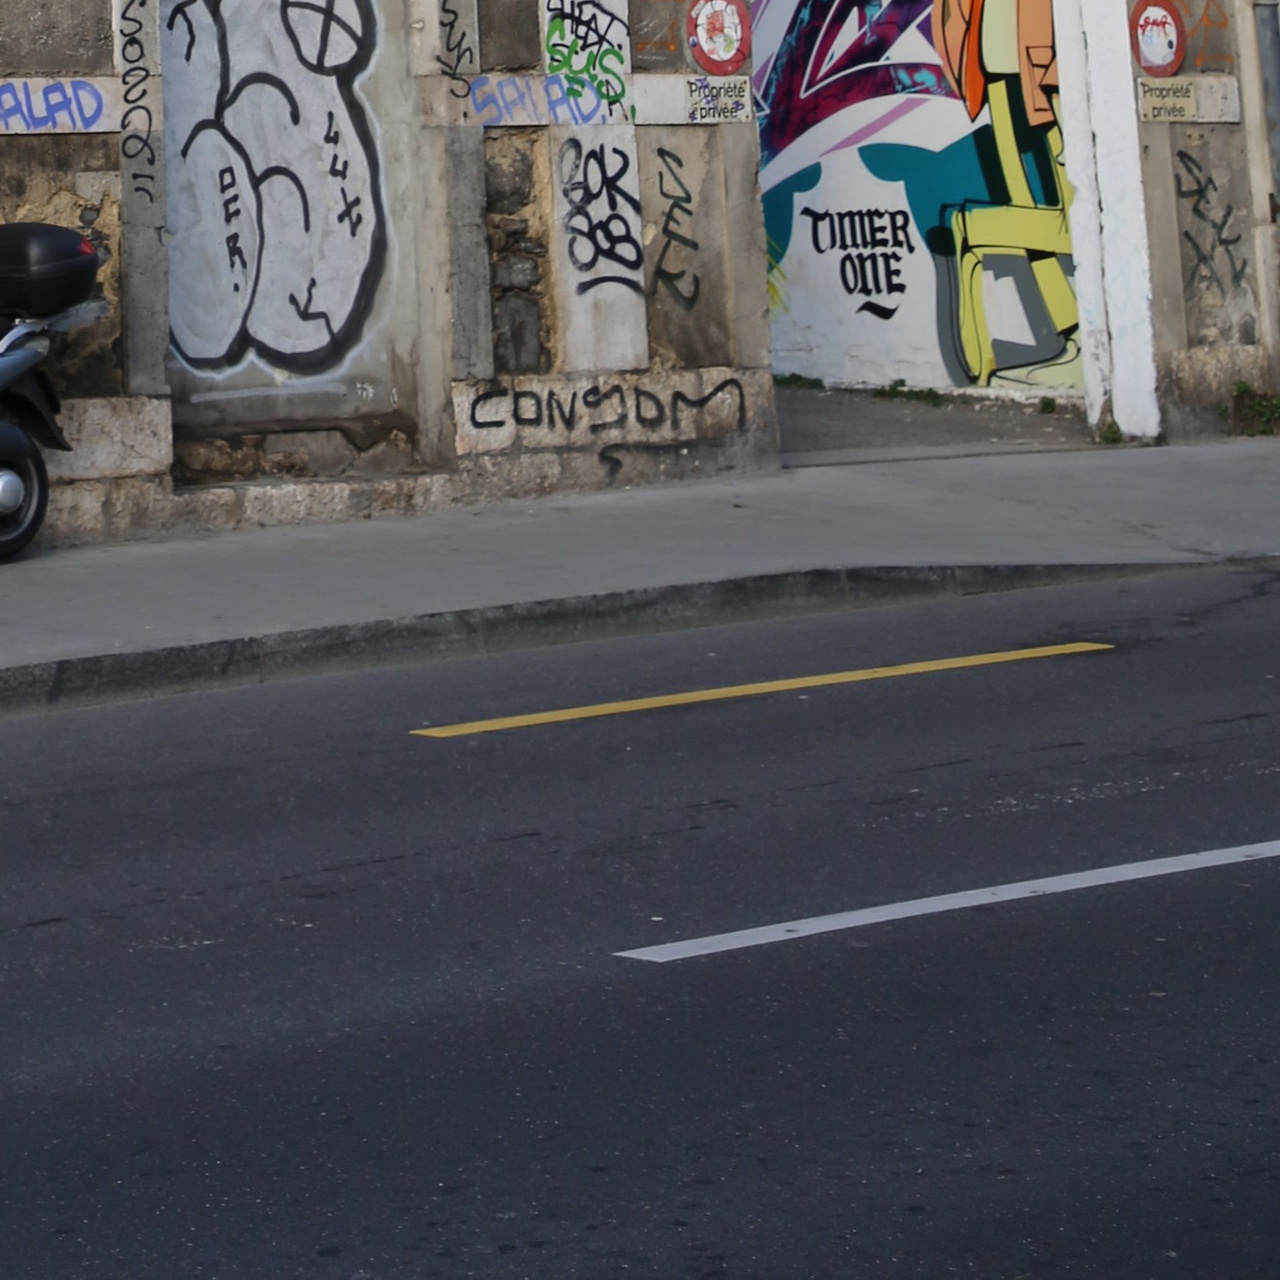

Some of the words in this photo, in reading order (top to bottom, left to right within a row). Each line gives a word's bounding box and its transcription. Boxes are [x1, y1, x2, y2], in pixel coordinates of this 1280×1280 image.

[689, 80, 746, 105] Propriété
[1141, 81, 1192, 104] Propriété
[700, 103, 738, 121] privée
[1151, 104, 1186, 120] privée
[839, 251, 907, 297] ONE
